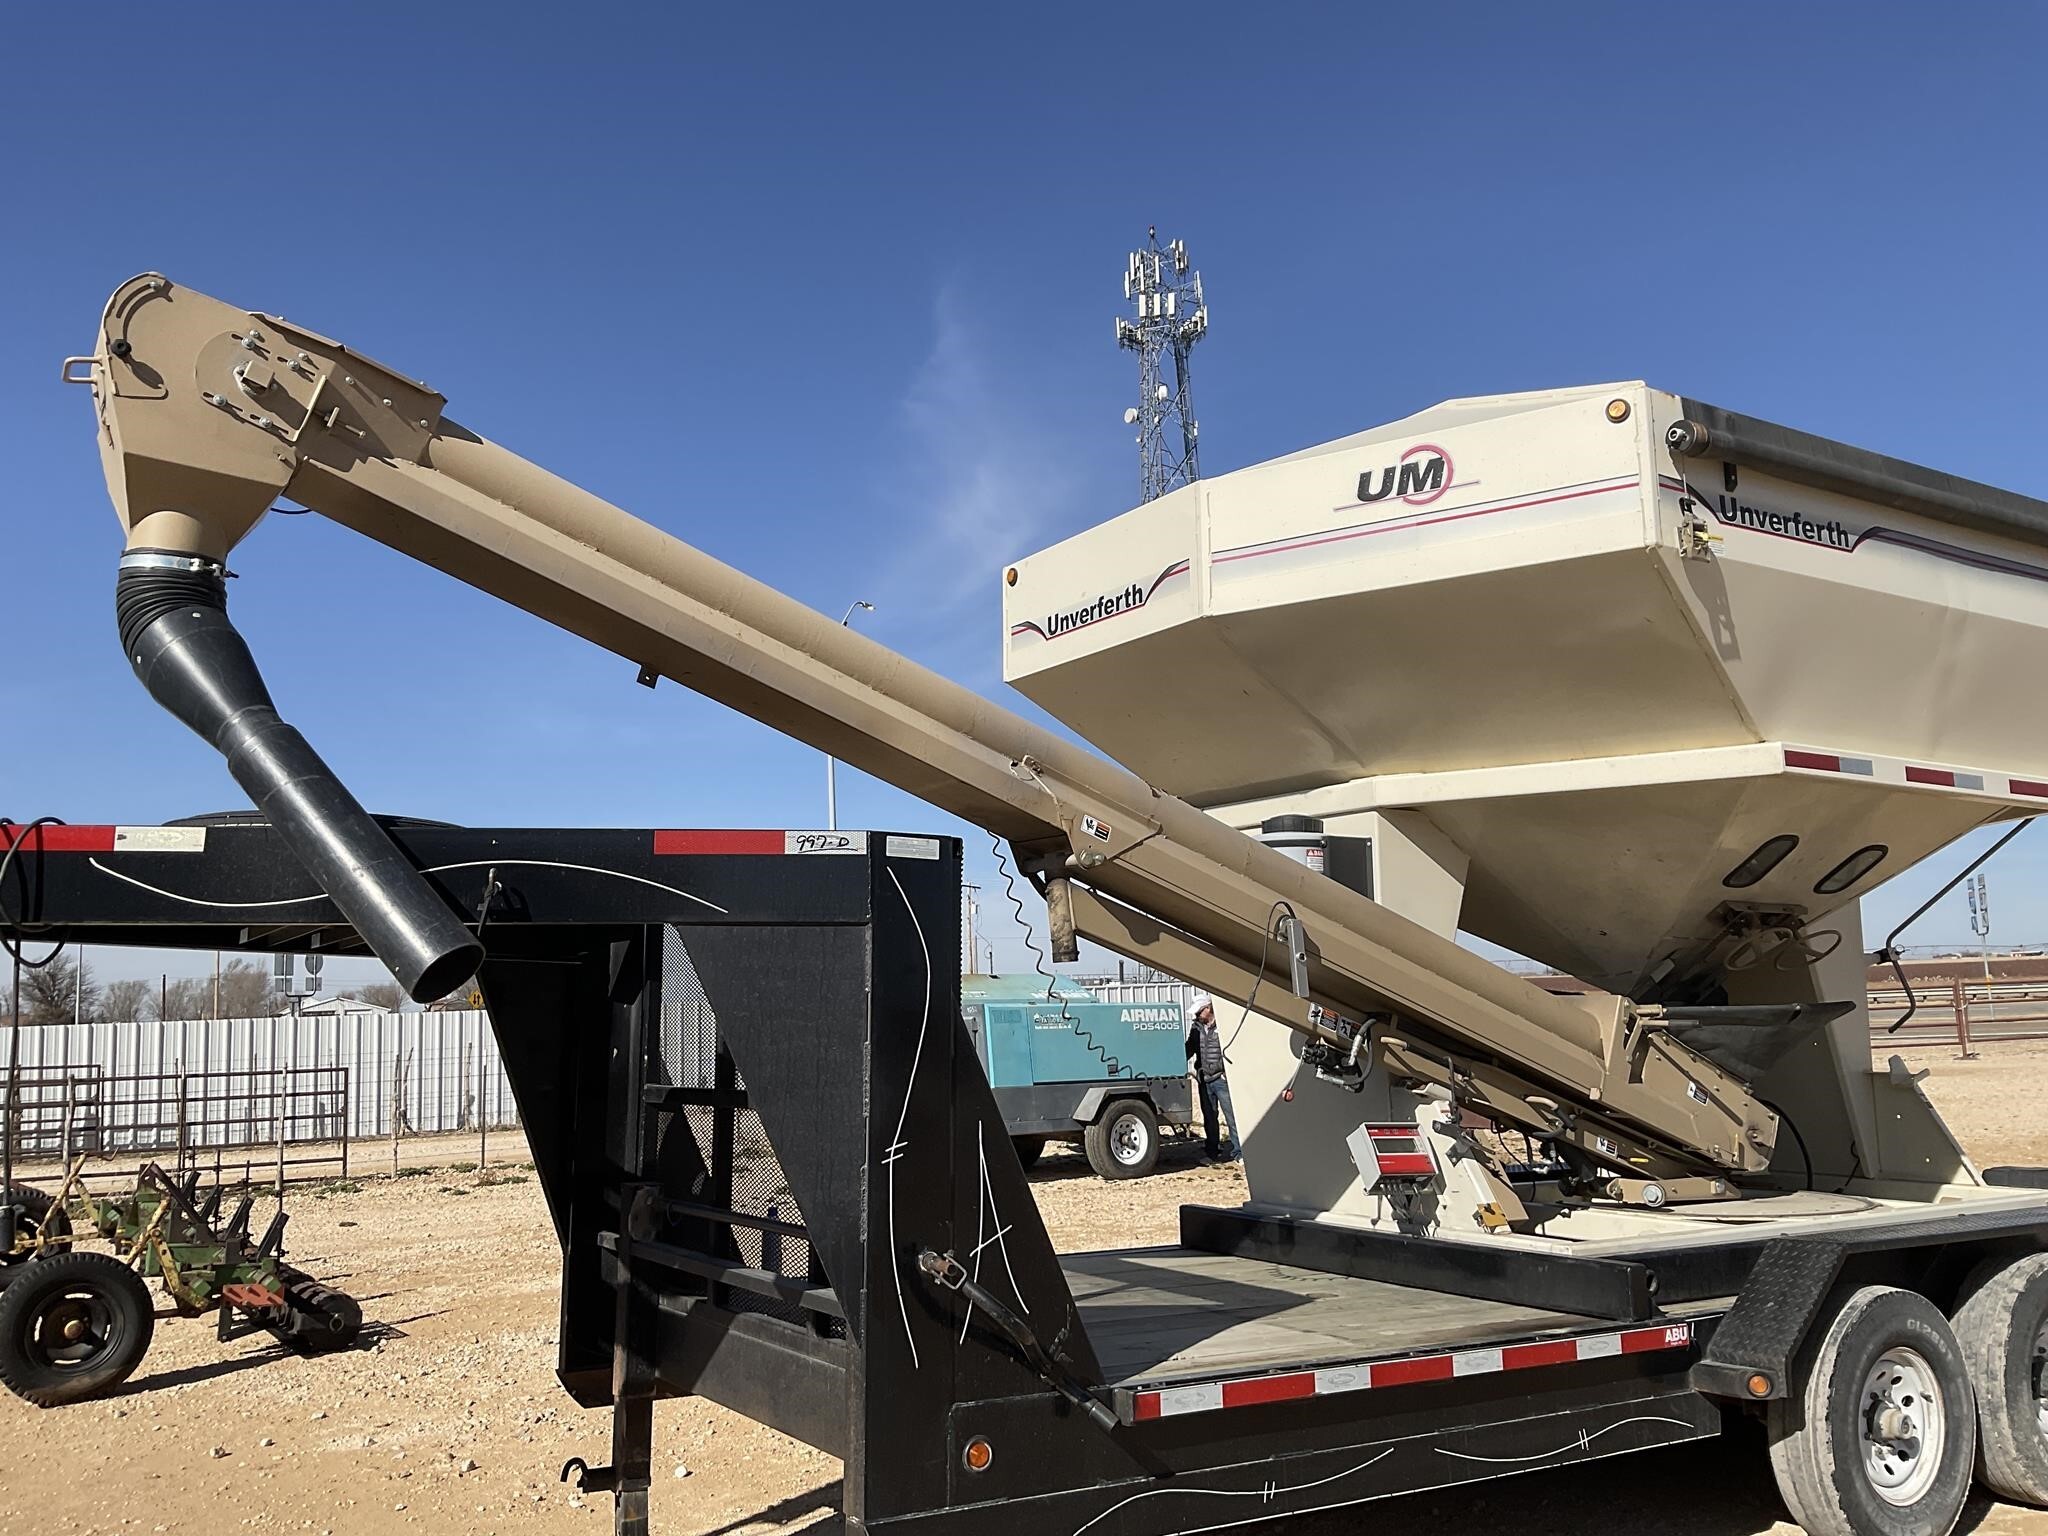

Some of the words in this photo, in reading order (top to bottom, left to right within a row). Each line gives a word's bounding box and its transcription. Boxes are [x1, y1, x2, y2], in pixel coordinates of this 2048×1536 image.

[1357, 457, 1445, 502] UM
[1719, 495, 1849, 547] Unverferth
[1048, 584, 1143, 635] Unverferth
[1120, 1008, 1179, 1022] AIRMAN
[1133, 1022, 1180, 1031] PDS400S
[1665, 1327, 1688, 1343] ABU
